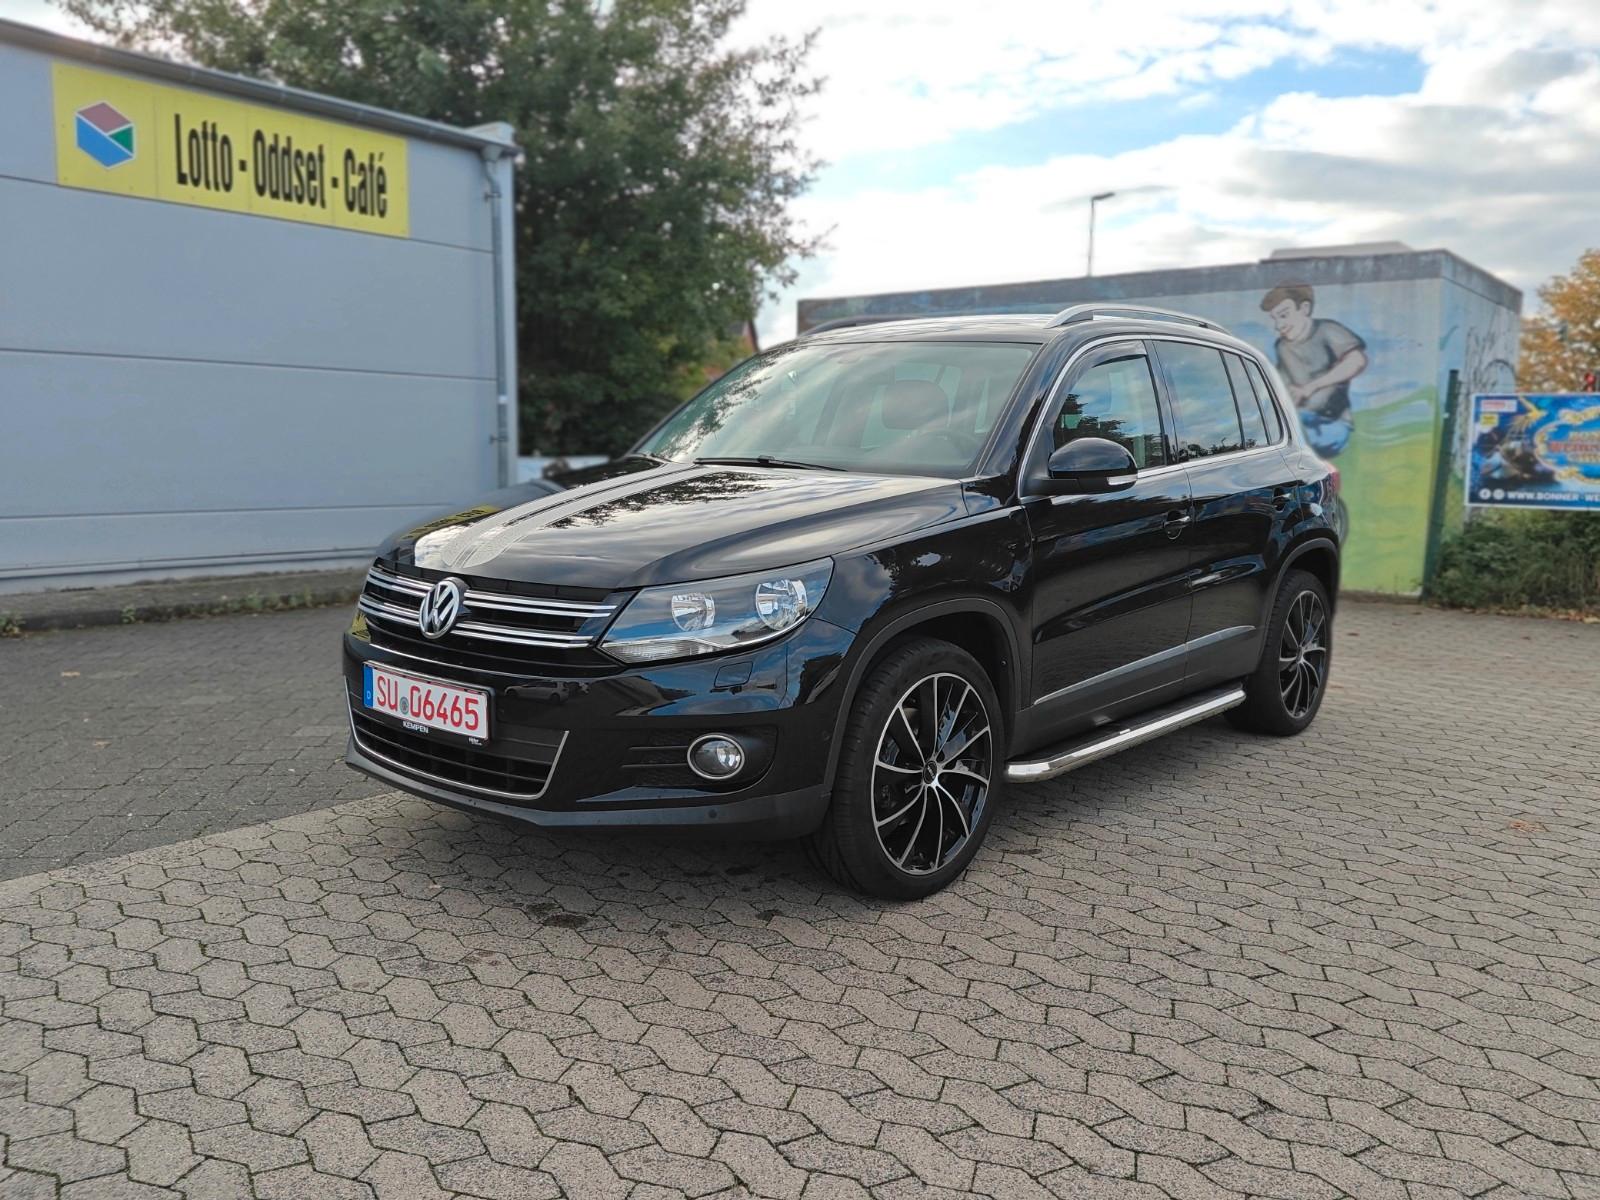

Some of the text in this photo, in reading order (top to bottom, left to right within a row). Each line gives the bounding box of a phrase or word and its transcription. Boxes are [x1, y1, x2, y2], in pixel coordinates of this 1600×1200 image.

[174, 113, 233, 192] Lotto
[253, 129, 326, 209] Oddset
[343, 148, 387, 218] Café
[366, 690, 372, 700] D
[377, 675, 479, 731] SU 06465
[402, 720, 429, 733] KEMPEN
